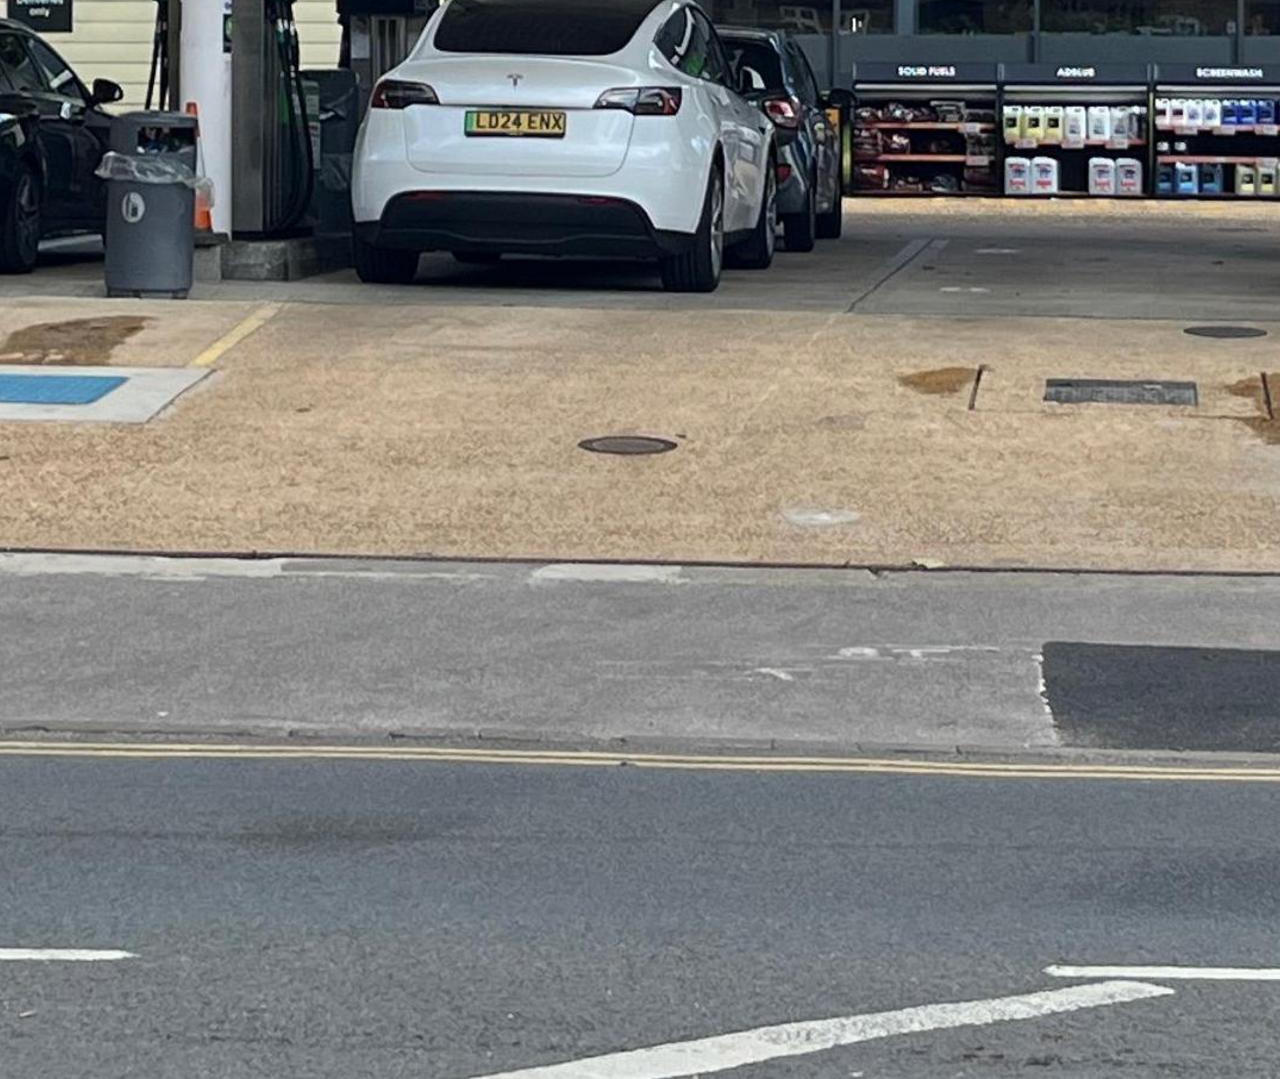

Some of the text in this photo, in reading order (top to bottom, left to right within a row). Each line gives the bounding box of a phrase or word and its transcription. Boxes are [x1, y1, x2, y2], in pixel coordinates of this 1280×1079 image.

[29, 7, 50, 18] only
[898, 66, 927, 76] SOLID
[476, 112, 562, 130] LD24 ENX
